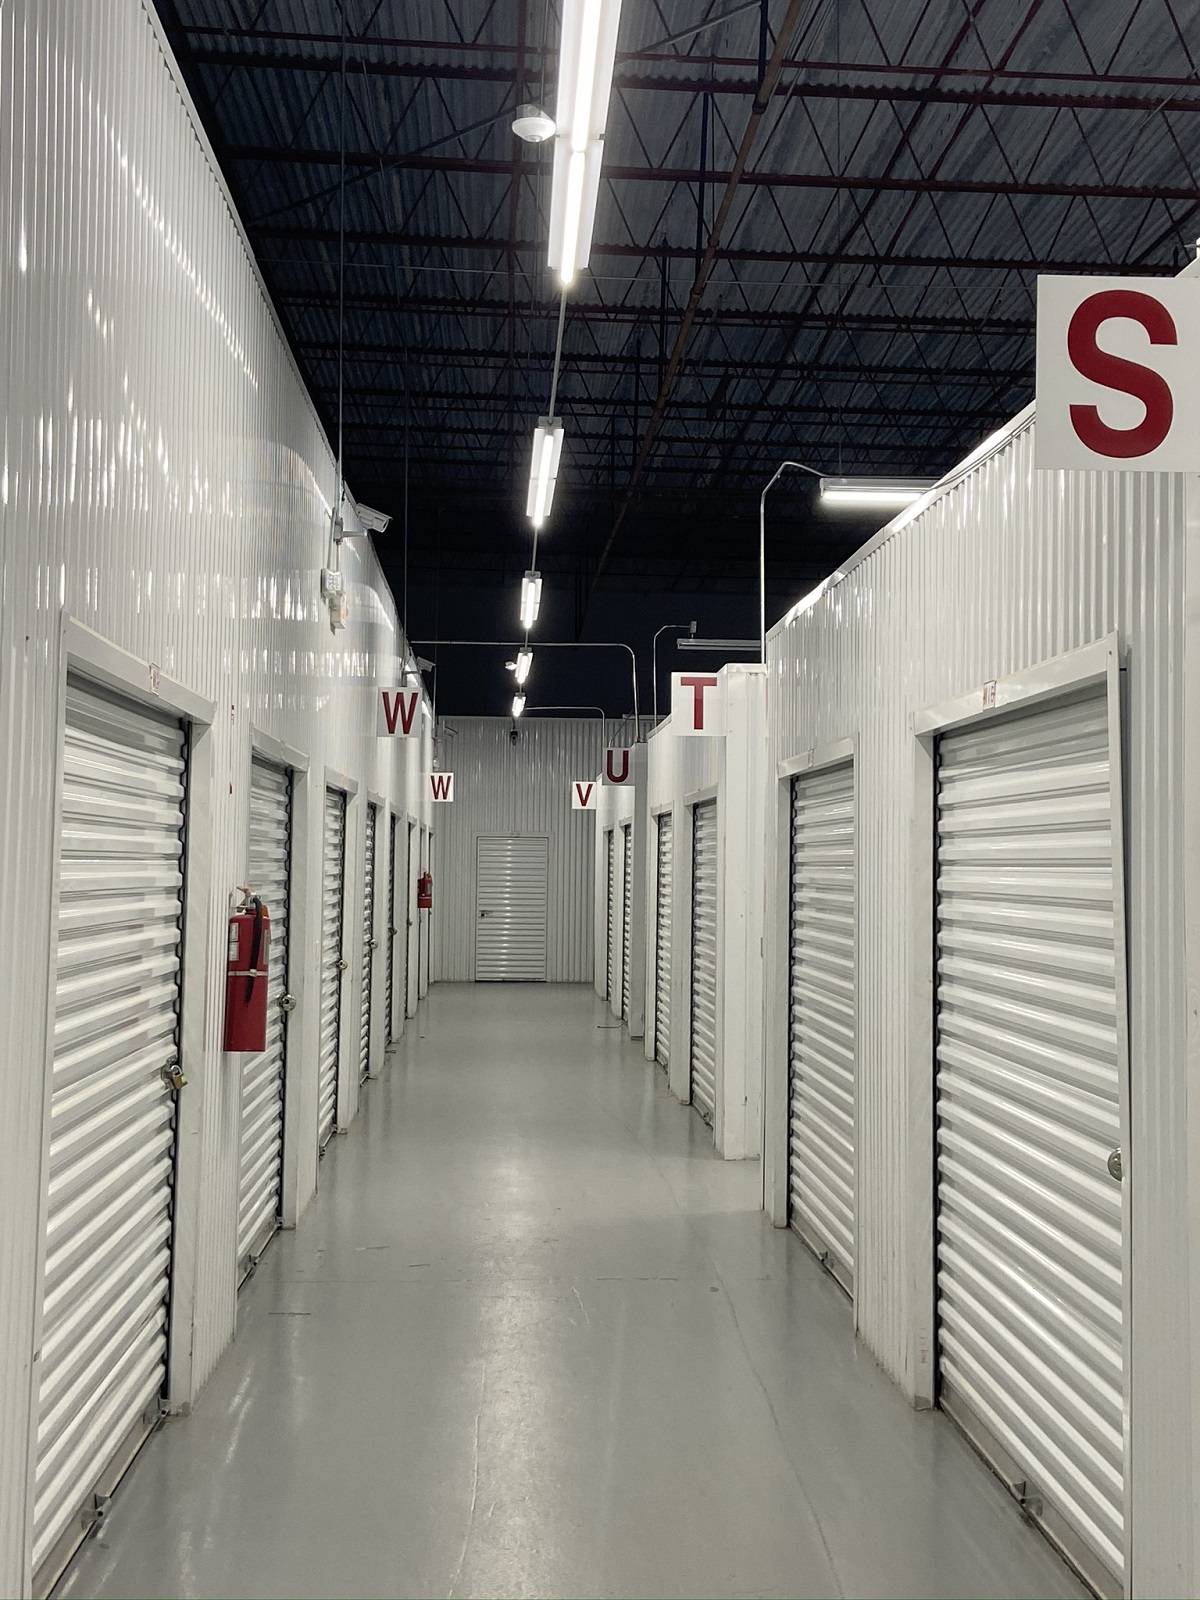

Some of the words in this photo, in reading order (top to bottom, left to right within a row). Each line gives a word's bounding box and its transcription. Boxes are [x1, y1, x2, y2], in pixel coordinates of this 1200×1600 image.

[1067, 289, 1178, 459] S
[382, 692, 419, 735] W
[680, 676, 718, 730] T
[606, 750, 629, 783] U
[430, 775, 452, 800] W
[575, 783, 594, 807] V
